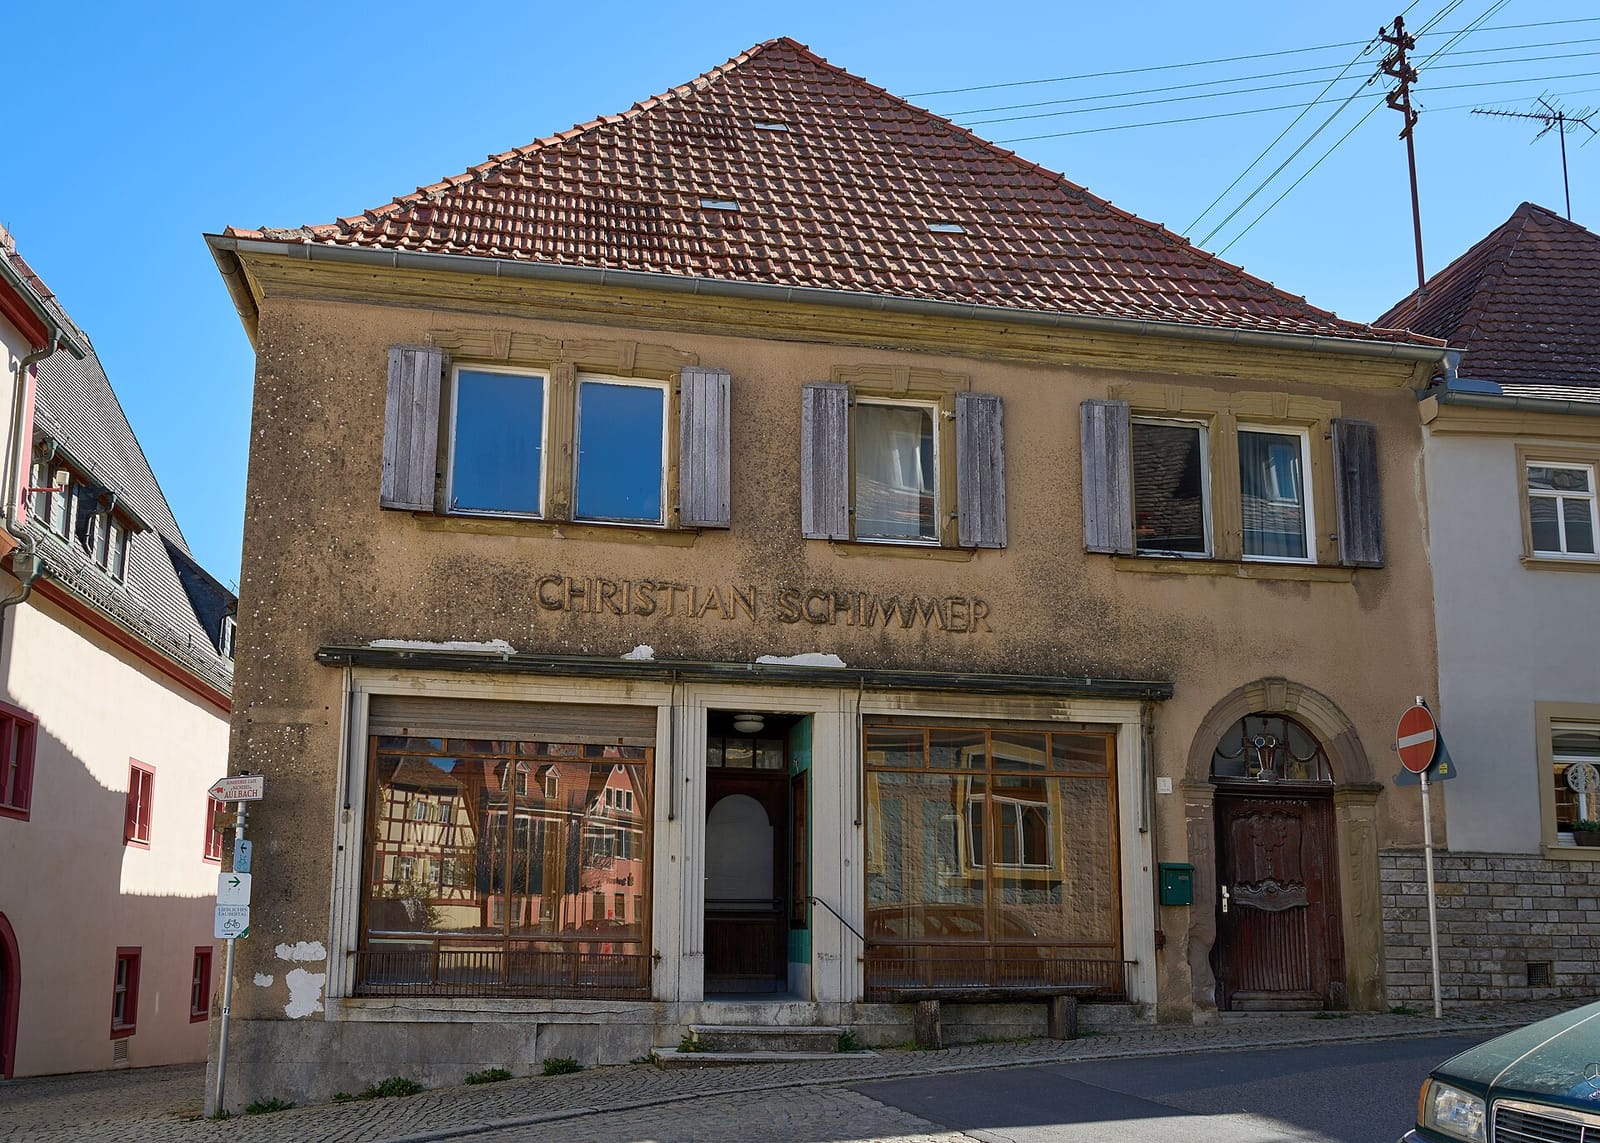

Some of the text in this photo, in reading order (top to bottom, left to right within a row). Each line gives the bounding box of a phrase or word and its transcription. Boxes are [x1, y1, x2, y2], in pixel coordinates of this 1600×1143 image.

[534, 575, 993, 633] CHRISTIAN SCHIMMER
[224, 789, 258, 798] AULBACH
